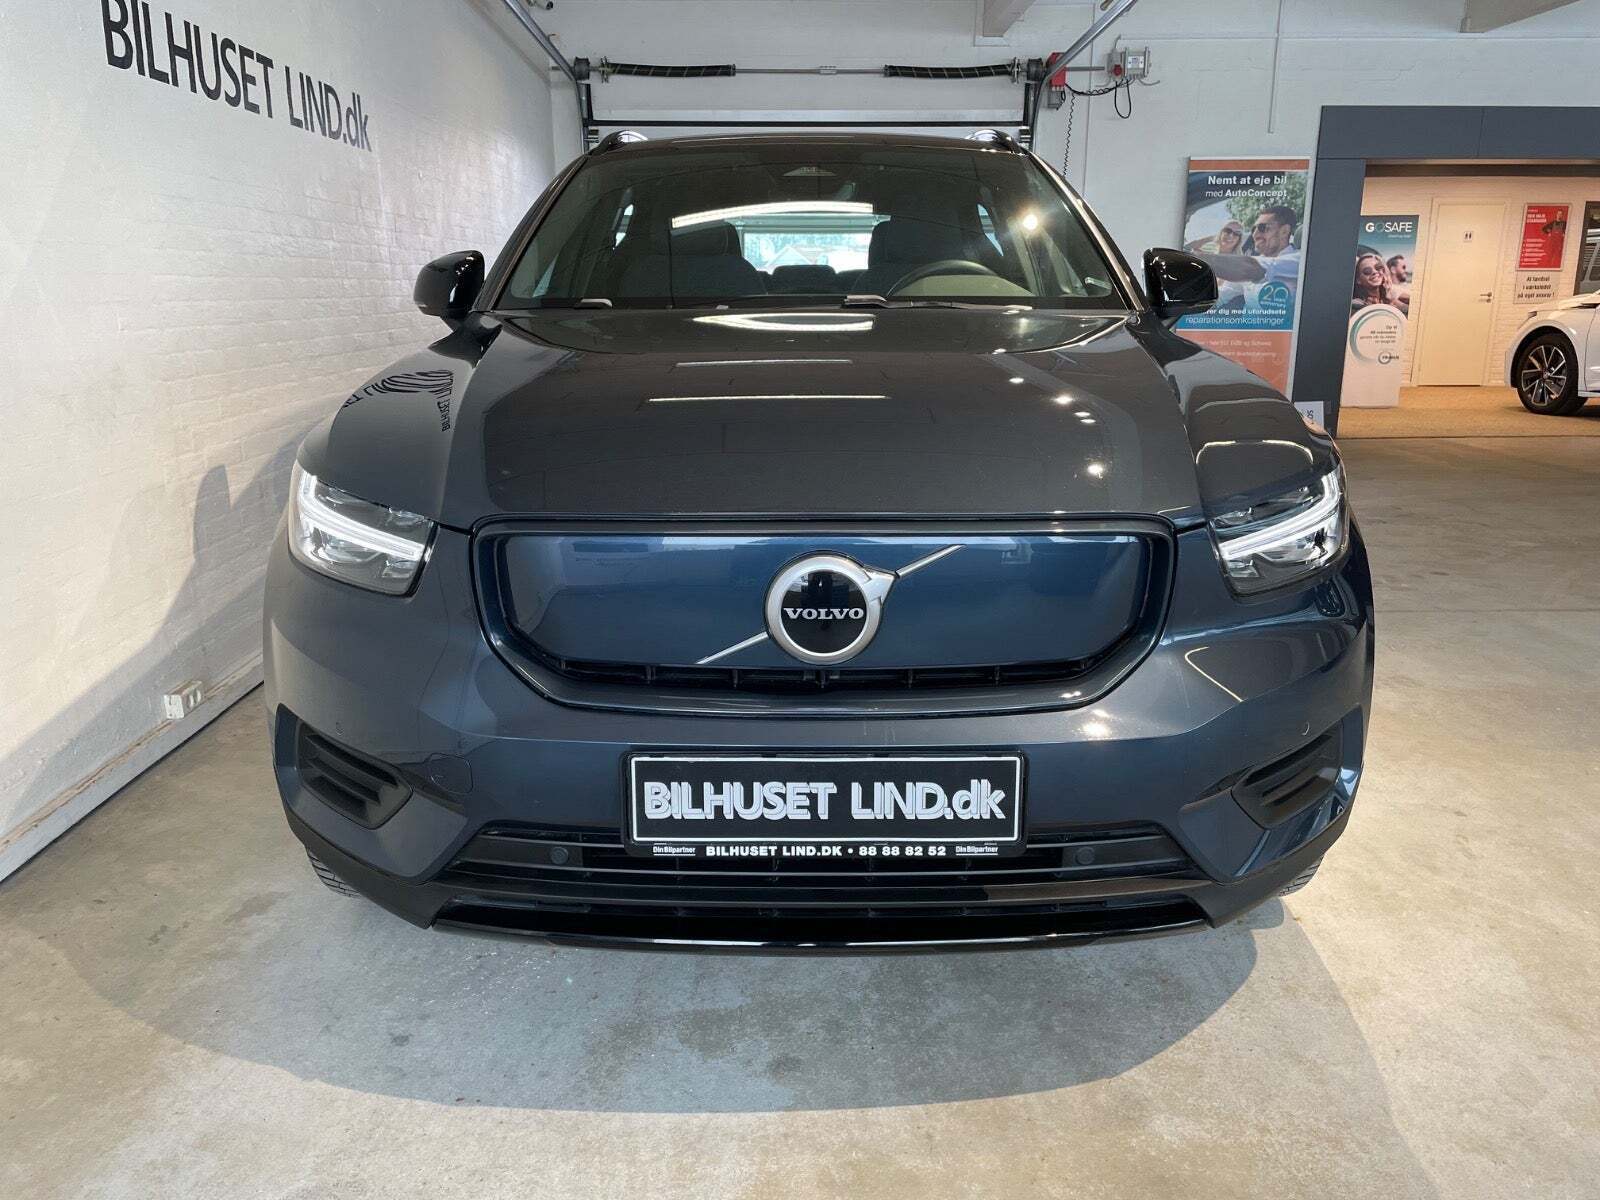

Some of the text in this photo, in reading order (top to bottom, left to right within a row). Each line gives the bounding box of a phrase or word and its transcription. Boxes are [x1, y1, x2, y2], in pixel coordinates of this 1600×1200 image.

[102, 0, 372, 152] BILHUSET LIND.dk
[1208, 175, 1287, 186] Nemt at eje bil
[1205, 188, 1287, 198] med AutoConcept
[1218, 308, 1230, 316] dig
[1231, 307, 1246, 315] med
[783, 607, 864, 620] VOLVO
[643, 779, 1006, 820] BILHUSET LIND.dk
[706, 846, 777, 856] BILHUSET
[782, 846, 842, 856] LIND.DK
[858, 846, 877, 856] 88
[882, 846, 900, 856] 88
[928, 846, 946, 856] 52
